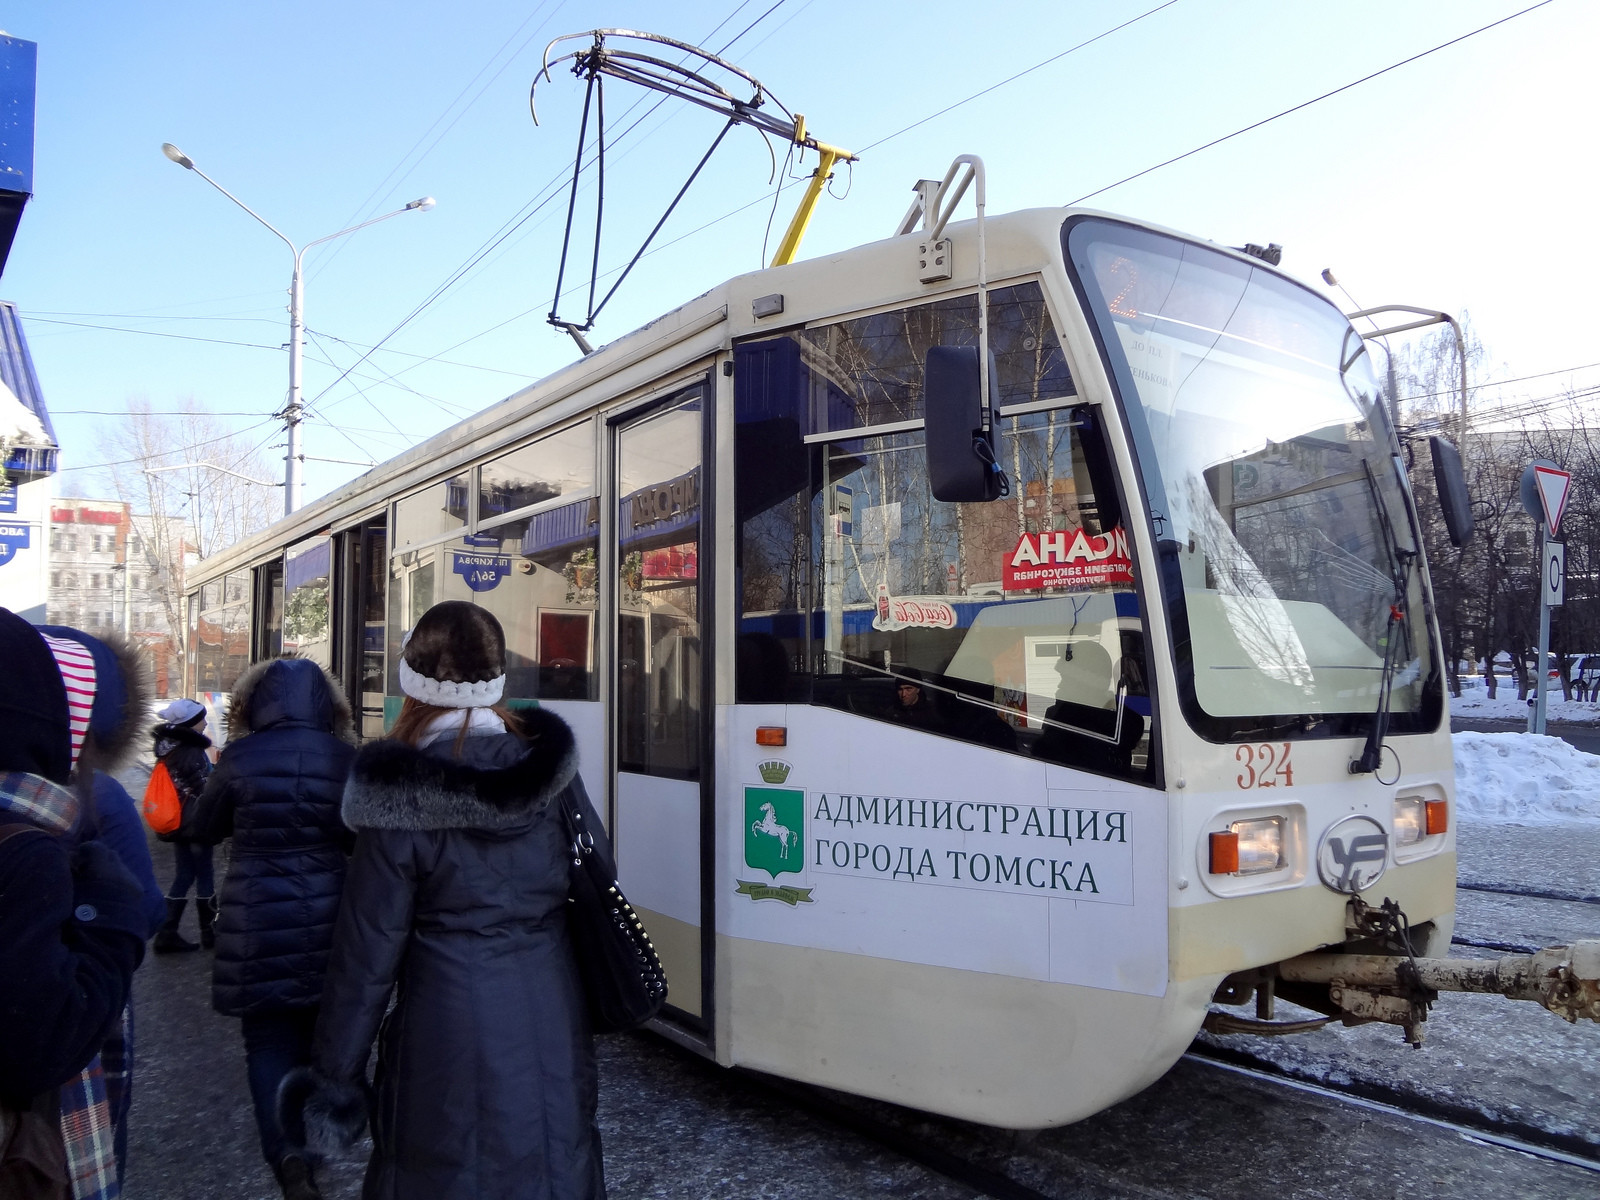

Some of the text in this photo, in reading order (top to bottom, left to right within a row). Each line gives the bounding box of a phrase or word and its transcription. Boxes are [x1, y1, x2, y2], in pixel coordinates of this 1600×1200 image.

[1110, 256, 1137, 318] 2
[1235, 742, 1294, 789] 324
[814, 794, 1127, 846] АДМИНИСТРАЦИЯ
[815, 839, 1100, 894] ГОРОДА ТОМСКА
